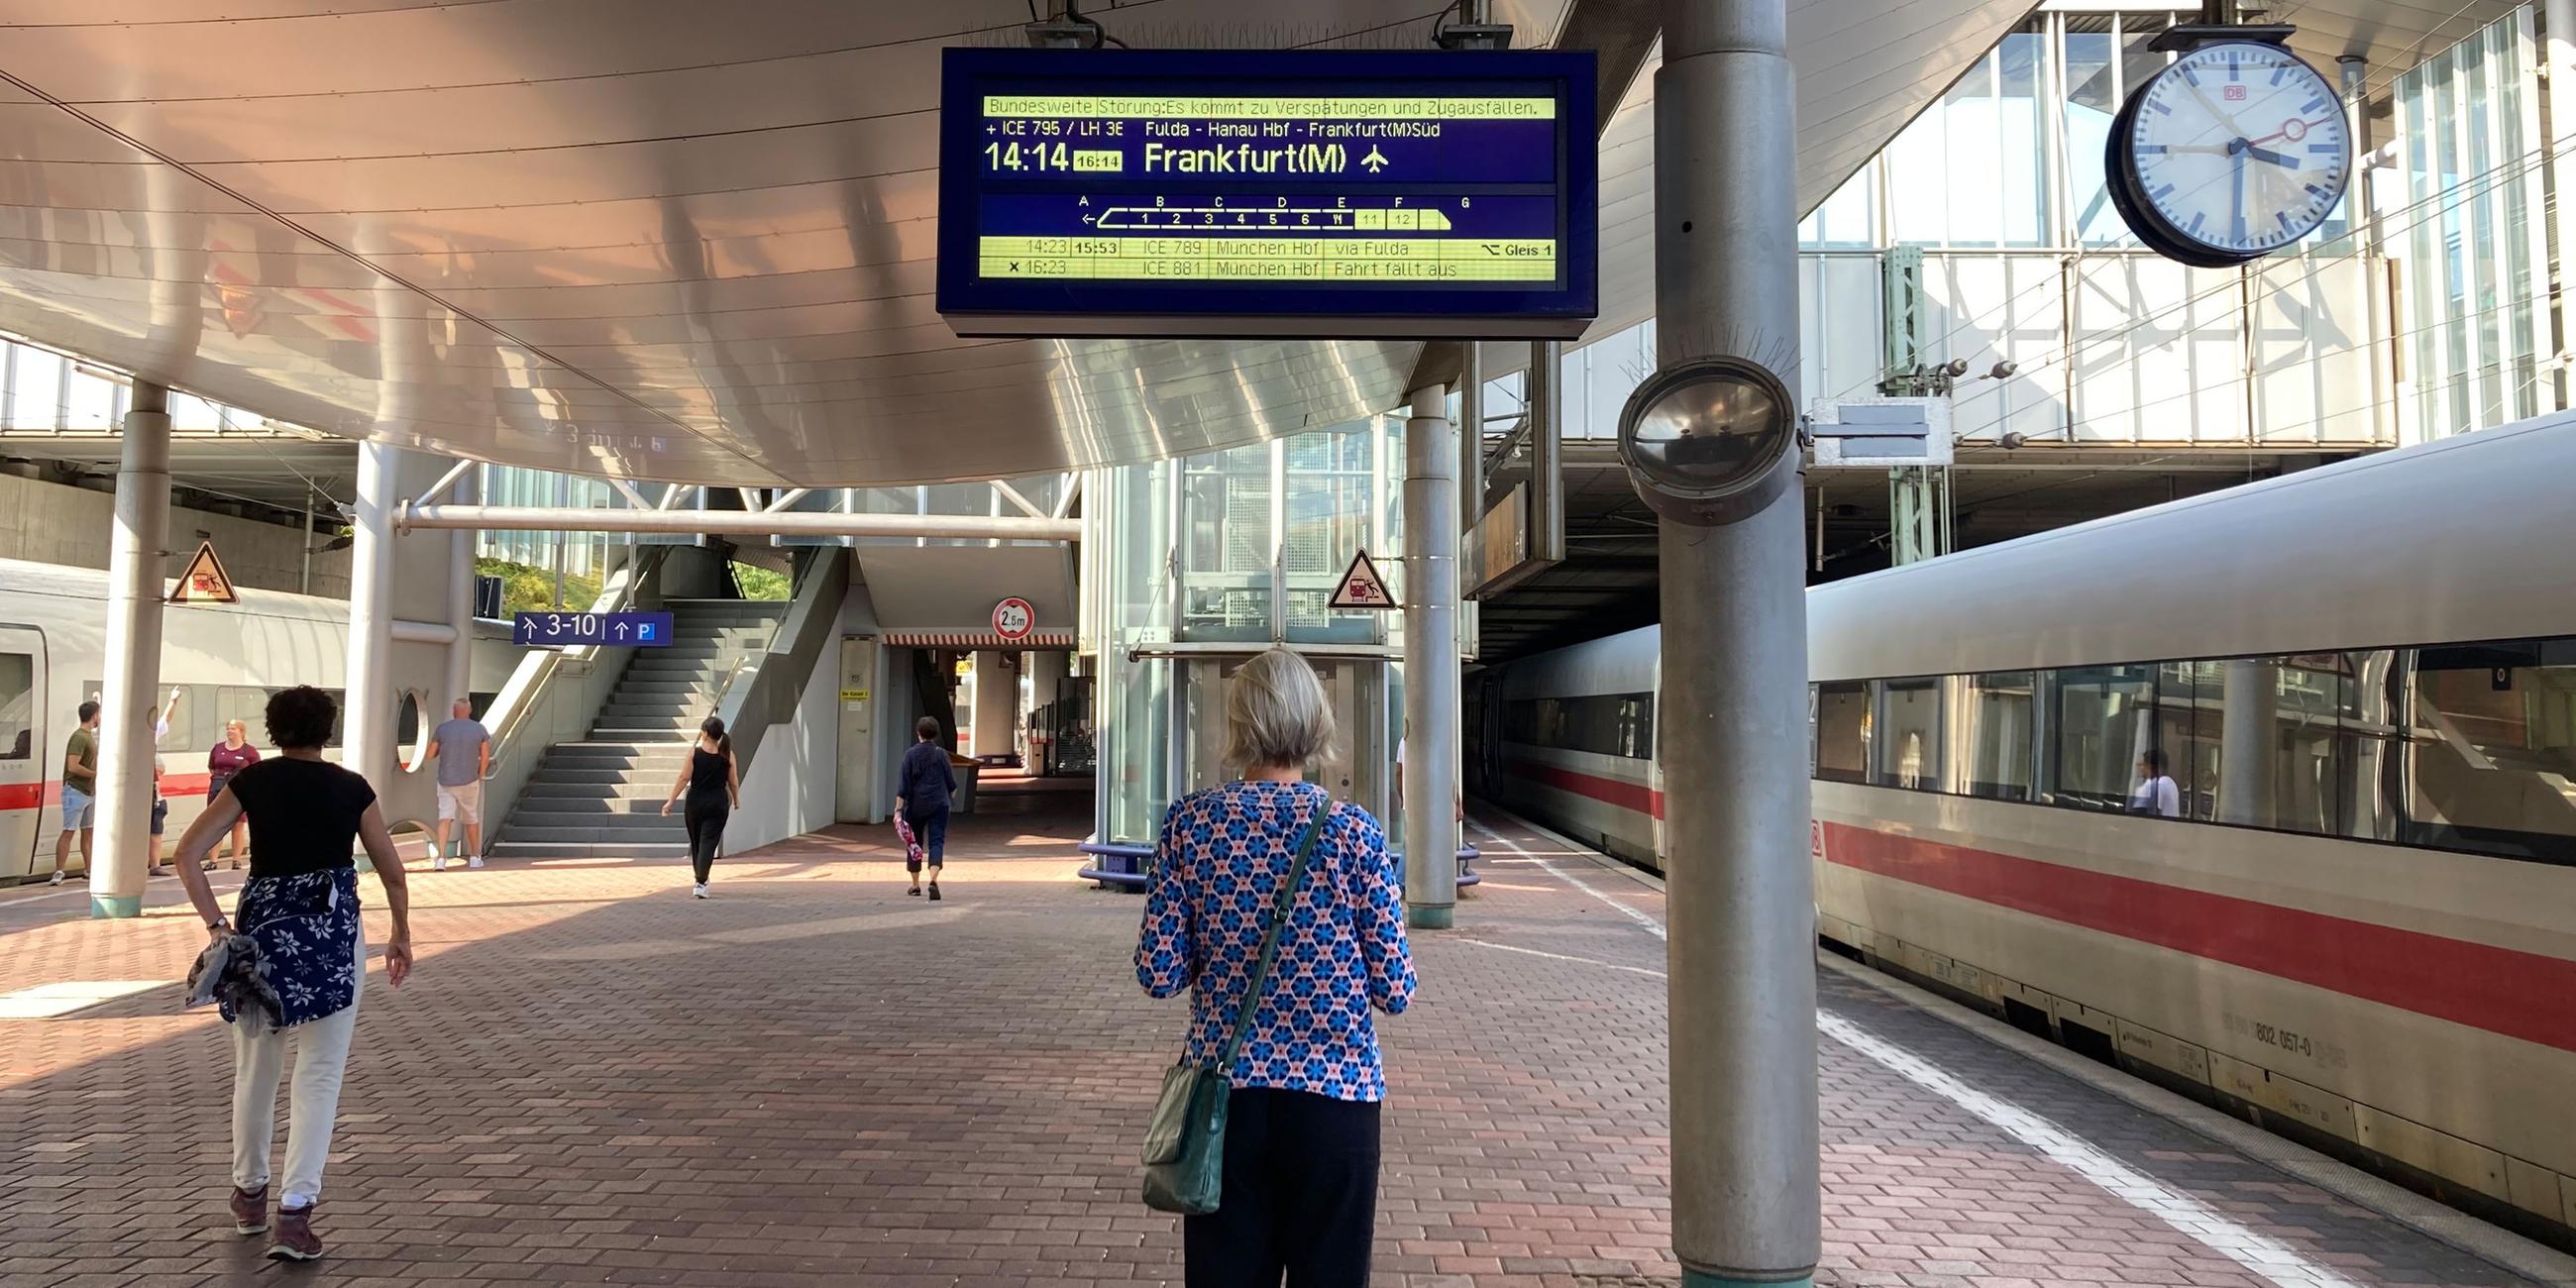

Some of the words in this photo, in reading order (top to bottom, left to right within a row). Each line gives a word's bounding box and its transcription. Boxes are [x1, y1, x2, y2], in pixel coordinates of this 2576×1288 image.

[990, 100, 1092, 115] Bundesweite
[1191, 100, 1244, 115] kommt
[1250, 103, 1269, 115] zu
[1276, 101, 1387, 118] Verspätungen
[1393, 101, 1421, 115] und
[1428, 101, 1538, 118] Zugausfällen.
[1002, 121, 1026, 135] ICE
[1032, 121, 1061, 135] 795
[1066, 121, 1074, 136] /
[1080, 121, 1100, 136] LH
[1145, 122, 1189, 137] Fulda
[1208, 122, 1257, 137] Hanau
[1263, 122, 1290, 137] Hbf
[1309, 122, 1441, 138] Frankfurt(M)Süd
[985, 142, 1069, 171] 14:14
[1076, 156, 1119, 167] 16:14
[1144, 143, 1346, 173] Frankfurt(M)
[1079, 196, 1089, 206] A
[1156, 196, 1164, 207] B
[1215, 196, 1224, 207] C
[1278, 197, 1287, 208] D
[1338, 197, 1345, 208] E
[1395, 197, 1403, 208] F
[1461, 197, 1469, 208] G
[1141, 213, 1148, 224] 1
[1172, 213, 1181, 224] 2
[1205, 213, 1214, 224] 3
[1237, 213, 1245, 224] 4
[1269, 214, 1277, 225] 5
[1302, 214, 1309, 225] 6
[1363, 214, 1377, 225] 11
[1395, 214, 1410, 225] 12
[1026, 240, 1067, 254] 14:23
[1075, 242, 1118, 254] 15:53
[1143, 241, 1165, 254] ICE
[1173, 241, 1202, 255] 789
[1293, 241, 1319, 256] Hbf
[1337, 242, 1358, 256] via
[1364, 241, 1409, 256] Fulda
[1505, 245, 1539, 256] Gleis
[1544, 246, 1552, 256] 1
[1026, 261, 1067, 274] 16:23
[1143, 262, 1165, 274] ICE
[1173, 262, 1202, 275] 881
[1217, 261, 1286, 275] München
[1293, 262, 1319, 276] Hbf
[1335, 262, 1378, 276] Fahrt
[1428, 265, 1457, 276] aus
[546, 614, 595, 636] 3-10
[639, 624, 650, 640] P
[2257, 1022, 2277, 1045] 802
[2280, 1029, 2311, 1057] 057-0
